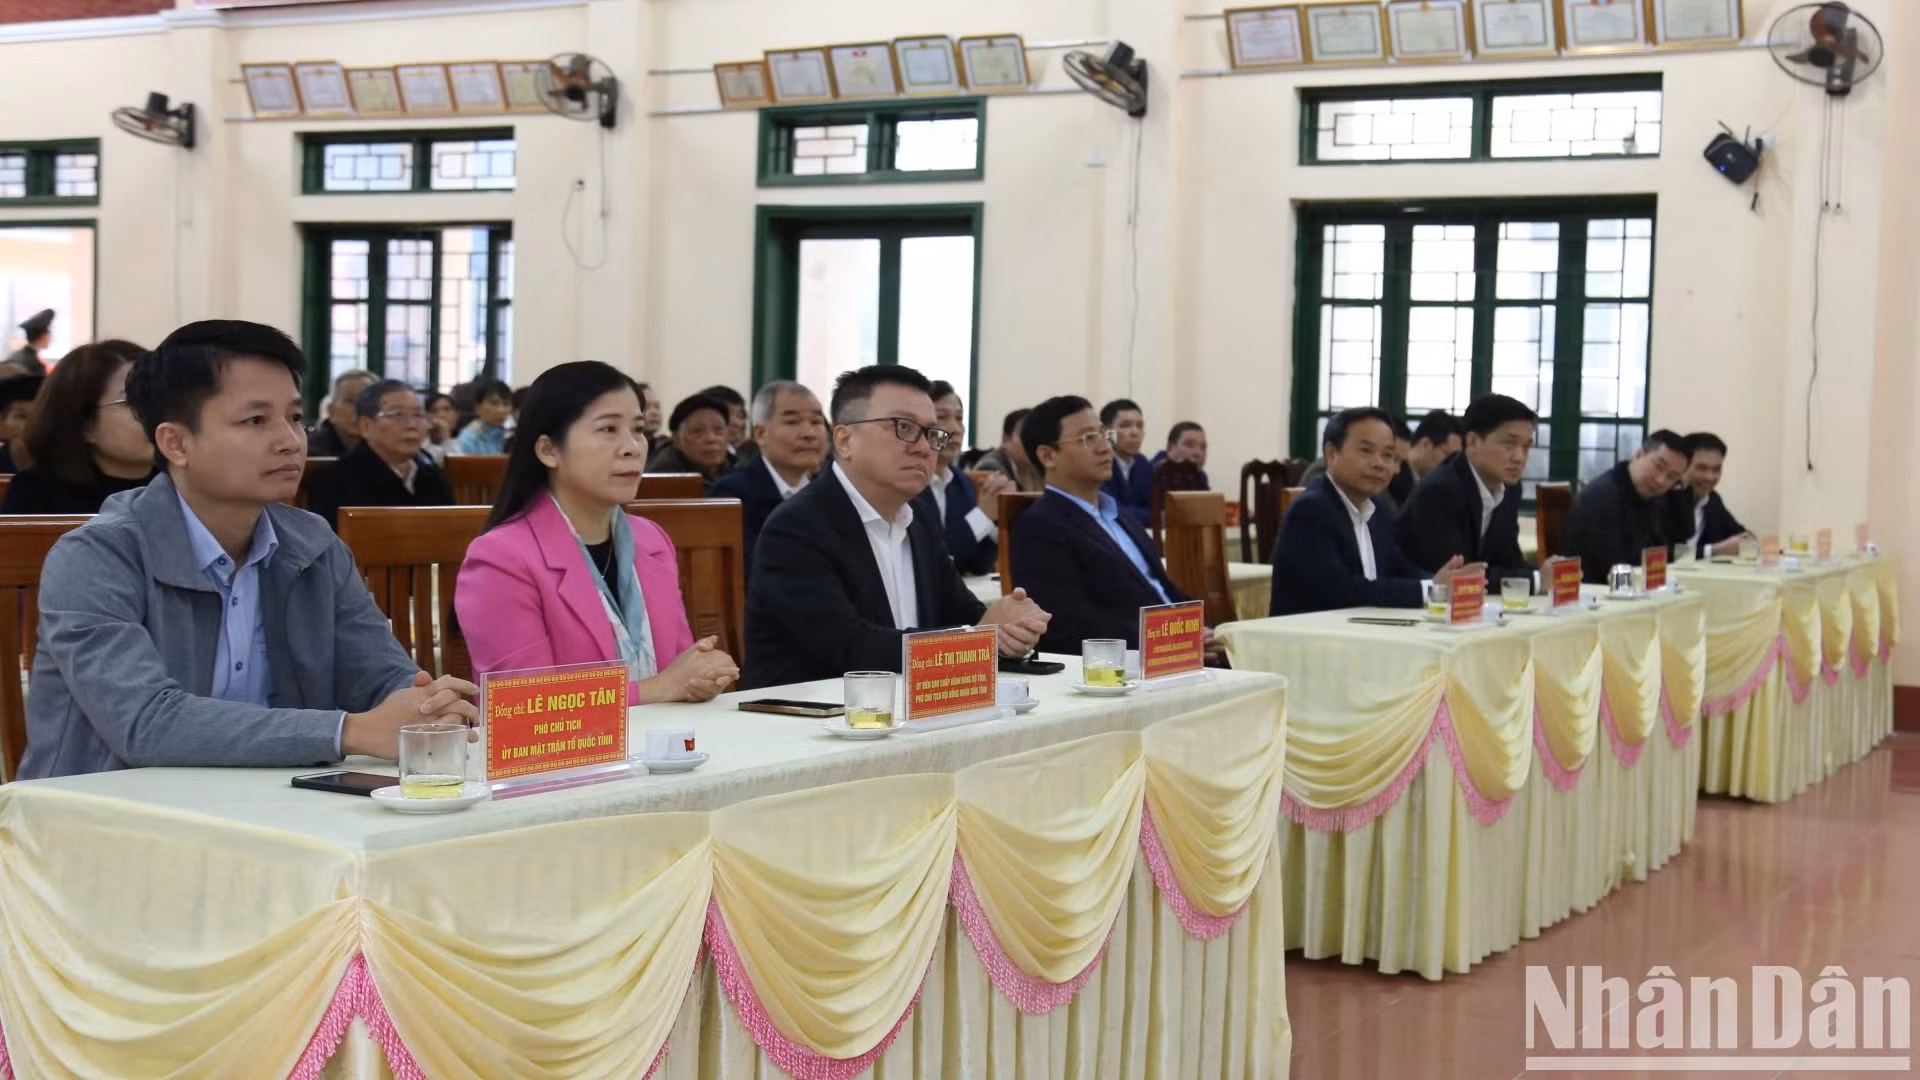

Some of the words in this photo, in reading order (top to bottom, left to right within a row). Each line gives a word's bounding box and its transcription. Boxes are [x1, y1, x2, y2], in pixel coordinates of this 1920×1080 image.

[1162, 620, 1168, 636] LÊ
[1170, 617, 1184, 637] QUỐC
[935, 650, 943, 666] LÊ
[944, 652, 954, 667] THỊ
[956, 649, 977, 664] THANH
[495, 702, 512, 718] Đồng
[514, 702, 525, 715] chí:
[527, 694, 543, 714] LÊ
[548, 692, 585, 712] NGỌC
[590, 687, 616, 706] TÂN
[534, 721, 548, 735] PHÓ
[550, 717, 564, 733] CHỦ
[566, 719, 582, 733] TỊCH
[502, 745, 512, 760] ỦY
[513, 746, 528, 758] BAN
[547, 740, 565, 754] TRẬN
[578, 733, 596, 749] QUỐC
[597, 732, 613, 746] TỈNH
